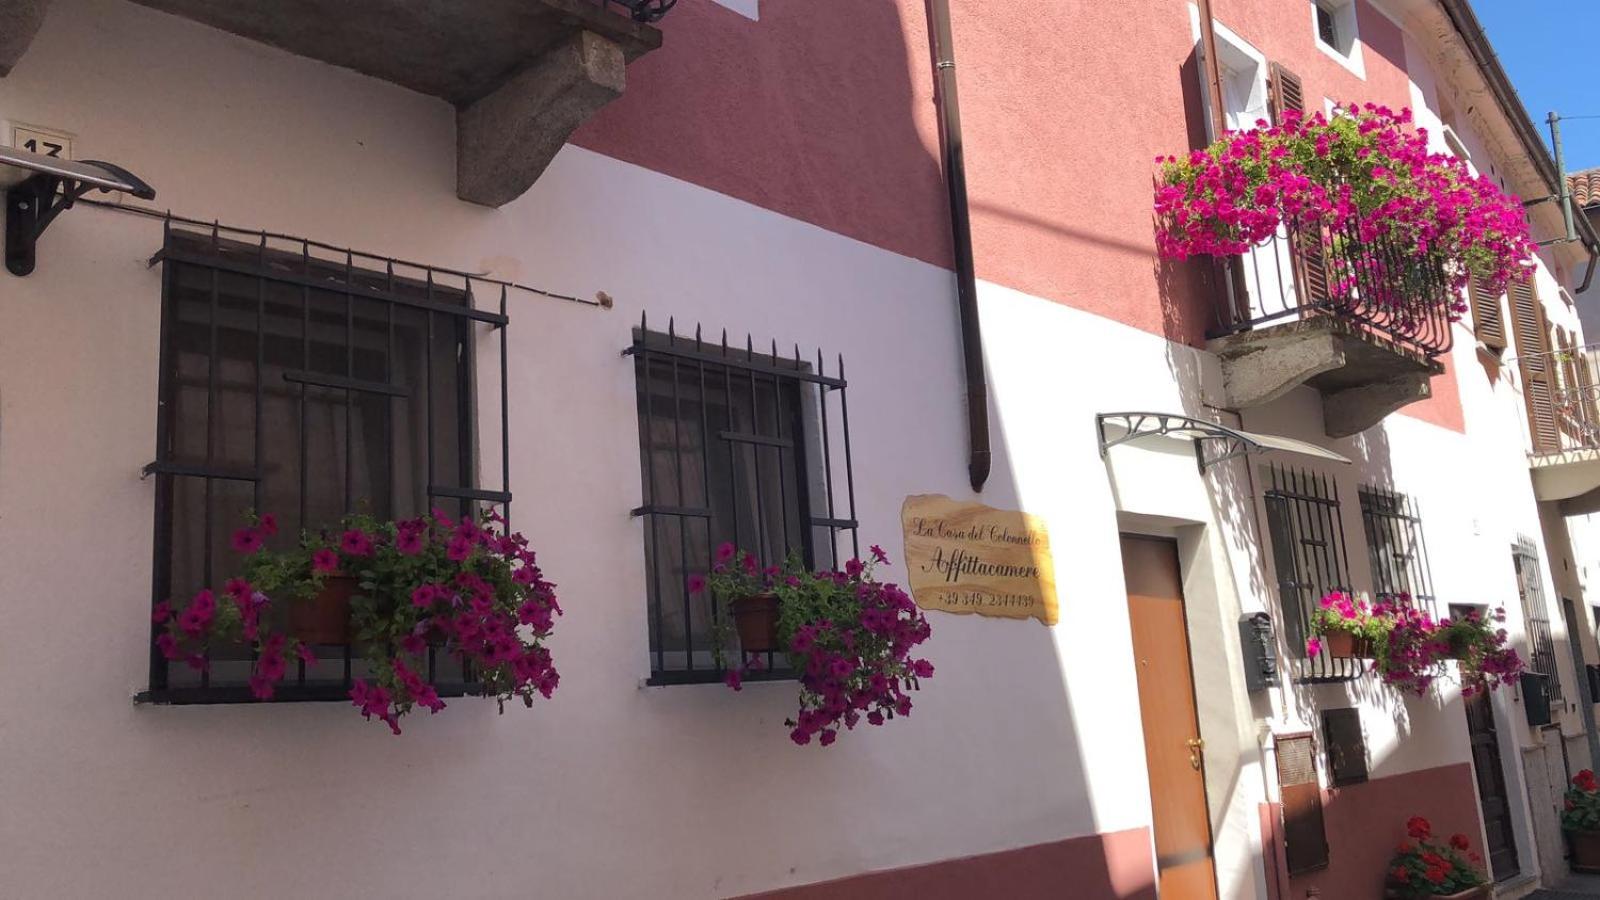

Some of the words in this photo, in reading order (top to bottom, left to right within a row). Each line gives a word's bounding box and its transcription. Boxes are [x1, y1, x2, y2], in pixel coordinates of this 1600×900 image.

[913, 517, 933, 537] La
[938, 520, 965, 540] Casa
[968, 525, 983, 541] del
[921, 546, 1040, 582] Affittacamere
